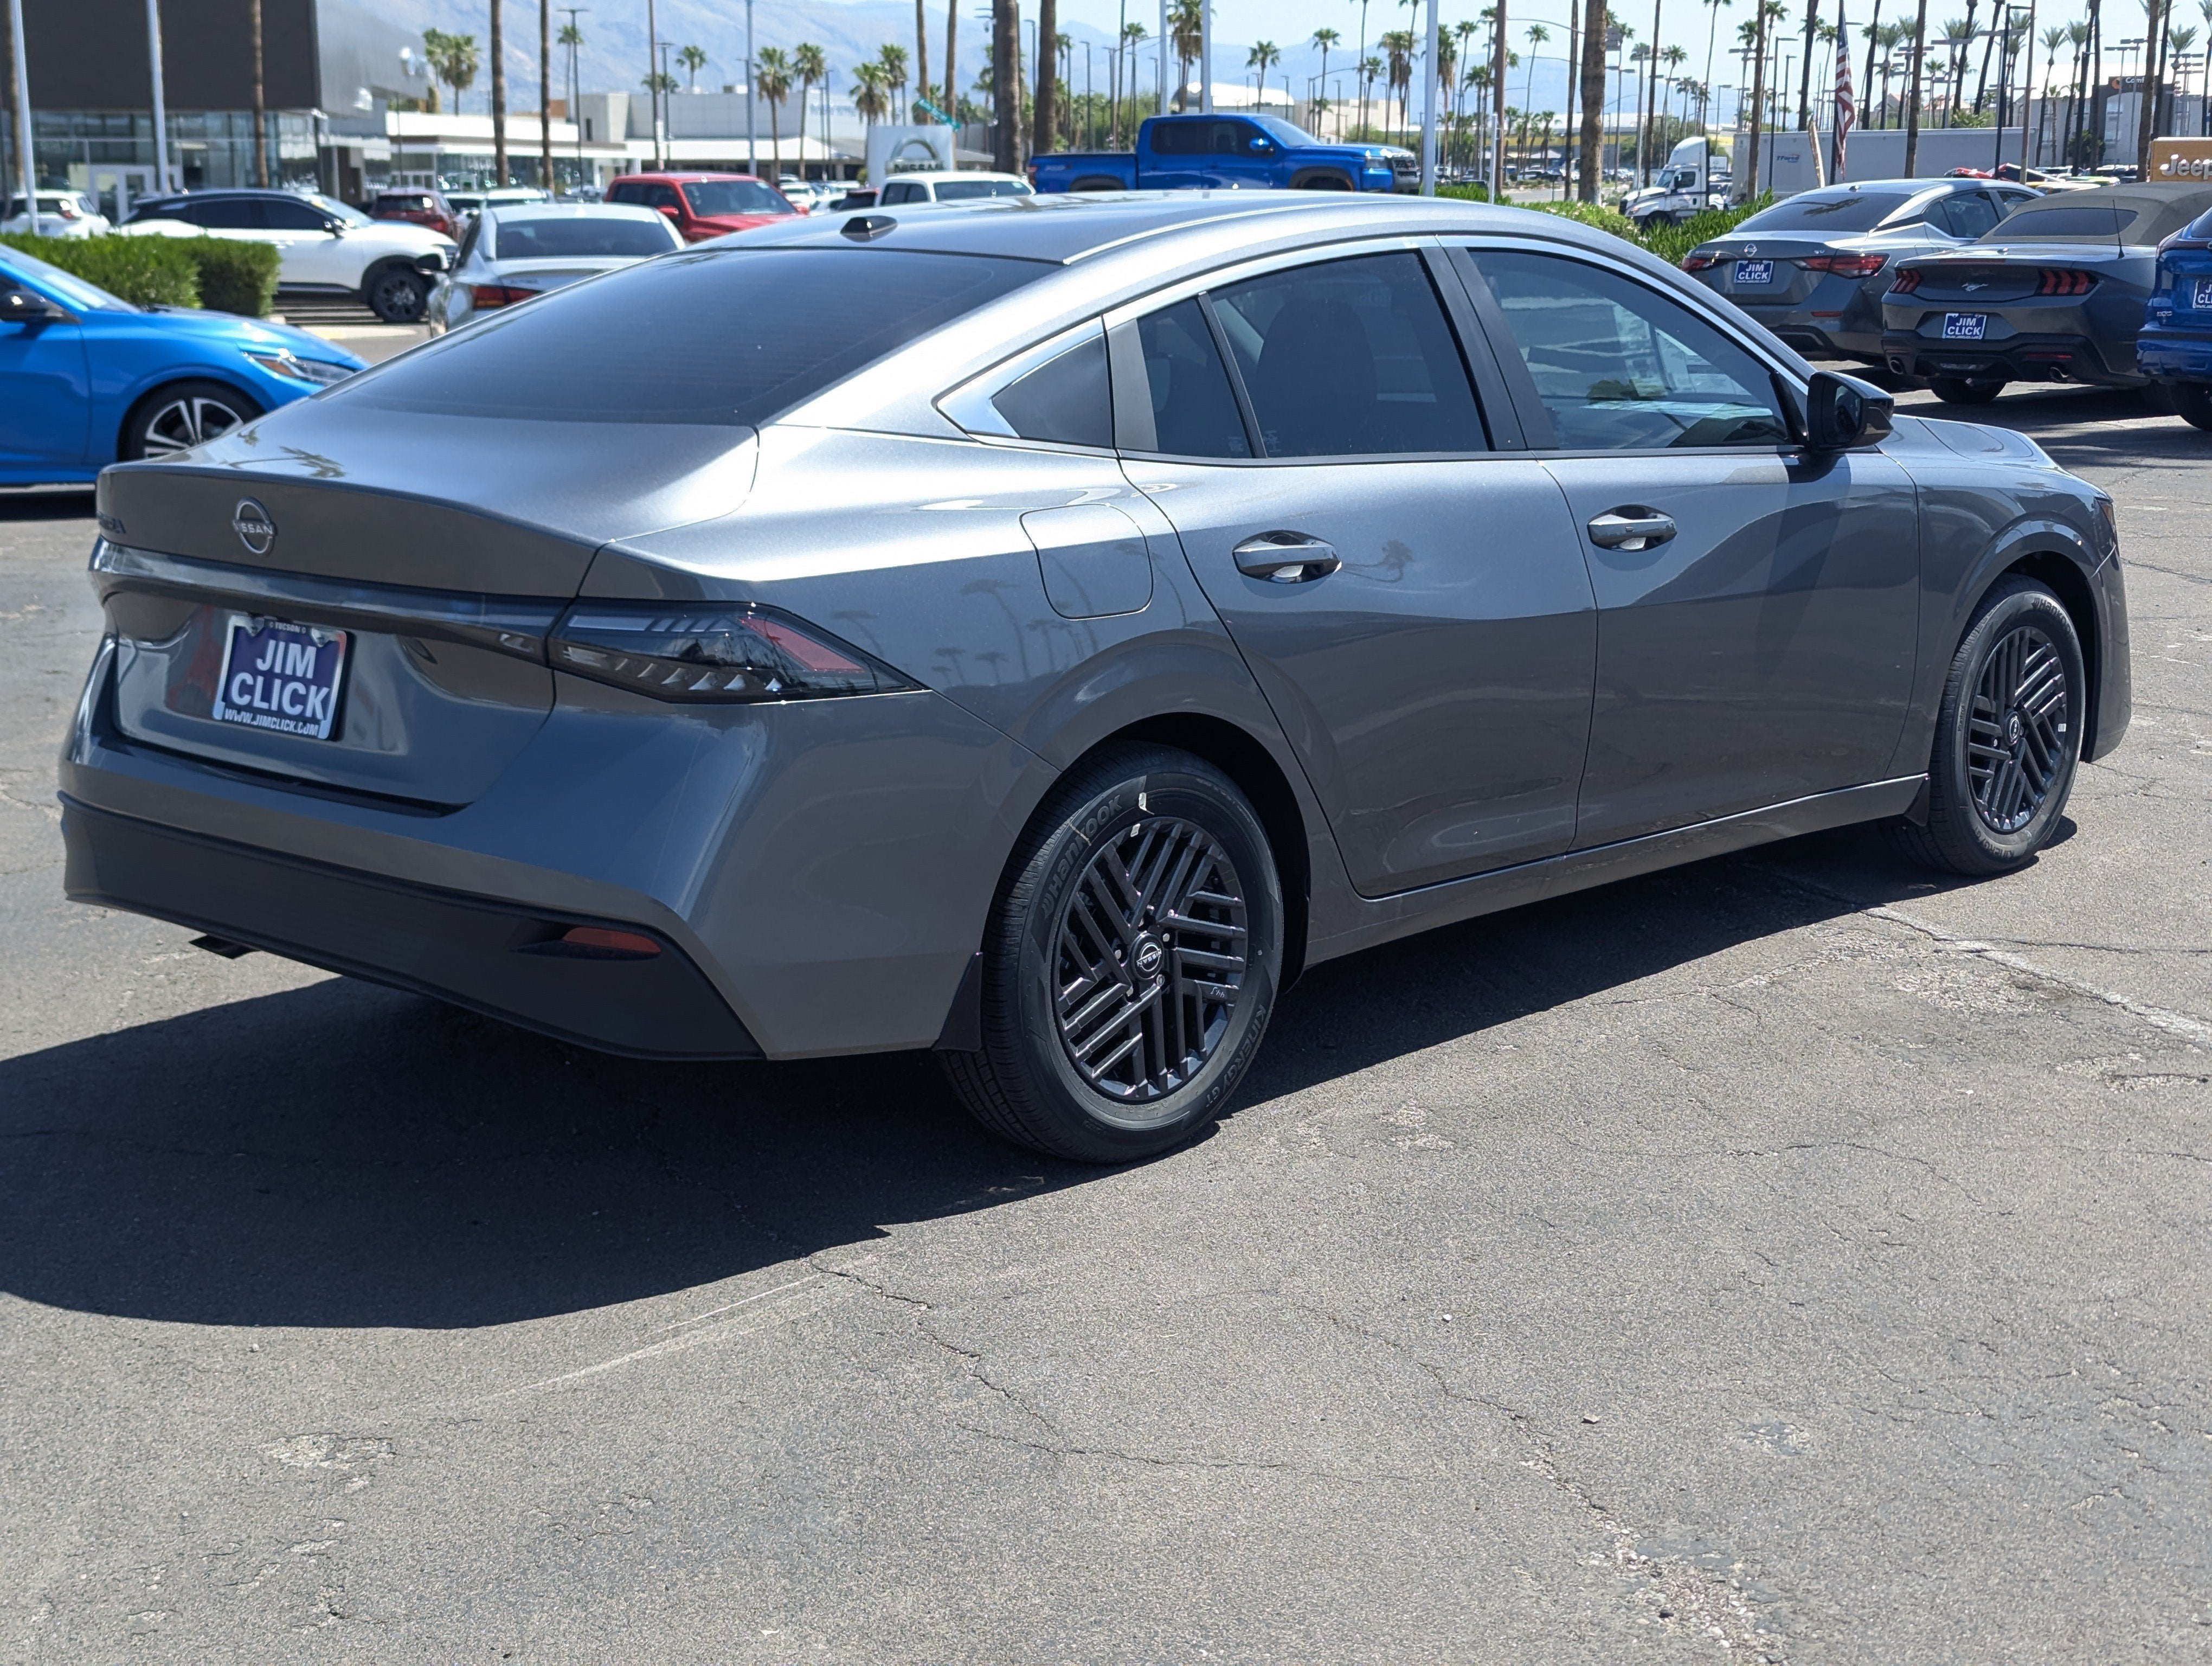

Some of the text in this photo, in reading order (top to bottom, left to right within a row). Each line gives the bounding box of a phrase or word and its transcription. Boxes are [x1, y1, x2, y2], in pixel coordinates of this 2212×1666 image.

[1956, 318, 1976, 326] JIM
[1947, 326, 1981, 335] CLICK
[275, 622, 299, 633] TUCSON
[255, 638, 317, 679] JIM
[230, 672, 330, 720] CLICK
